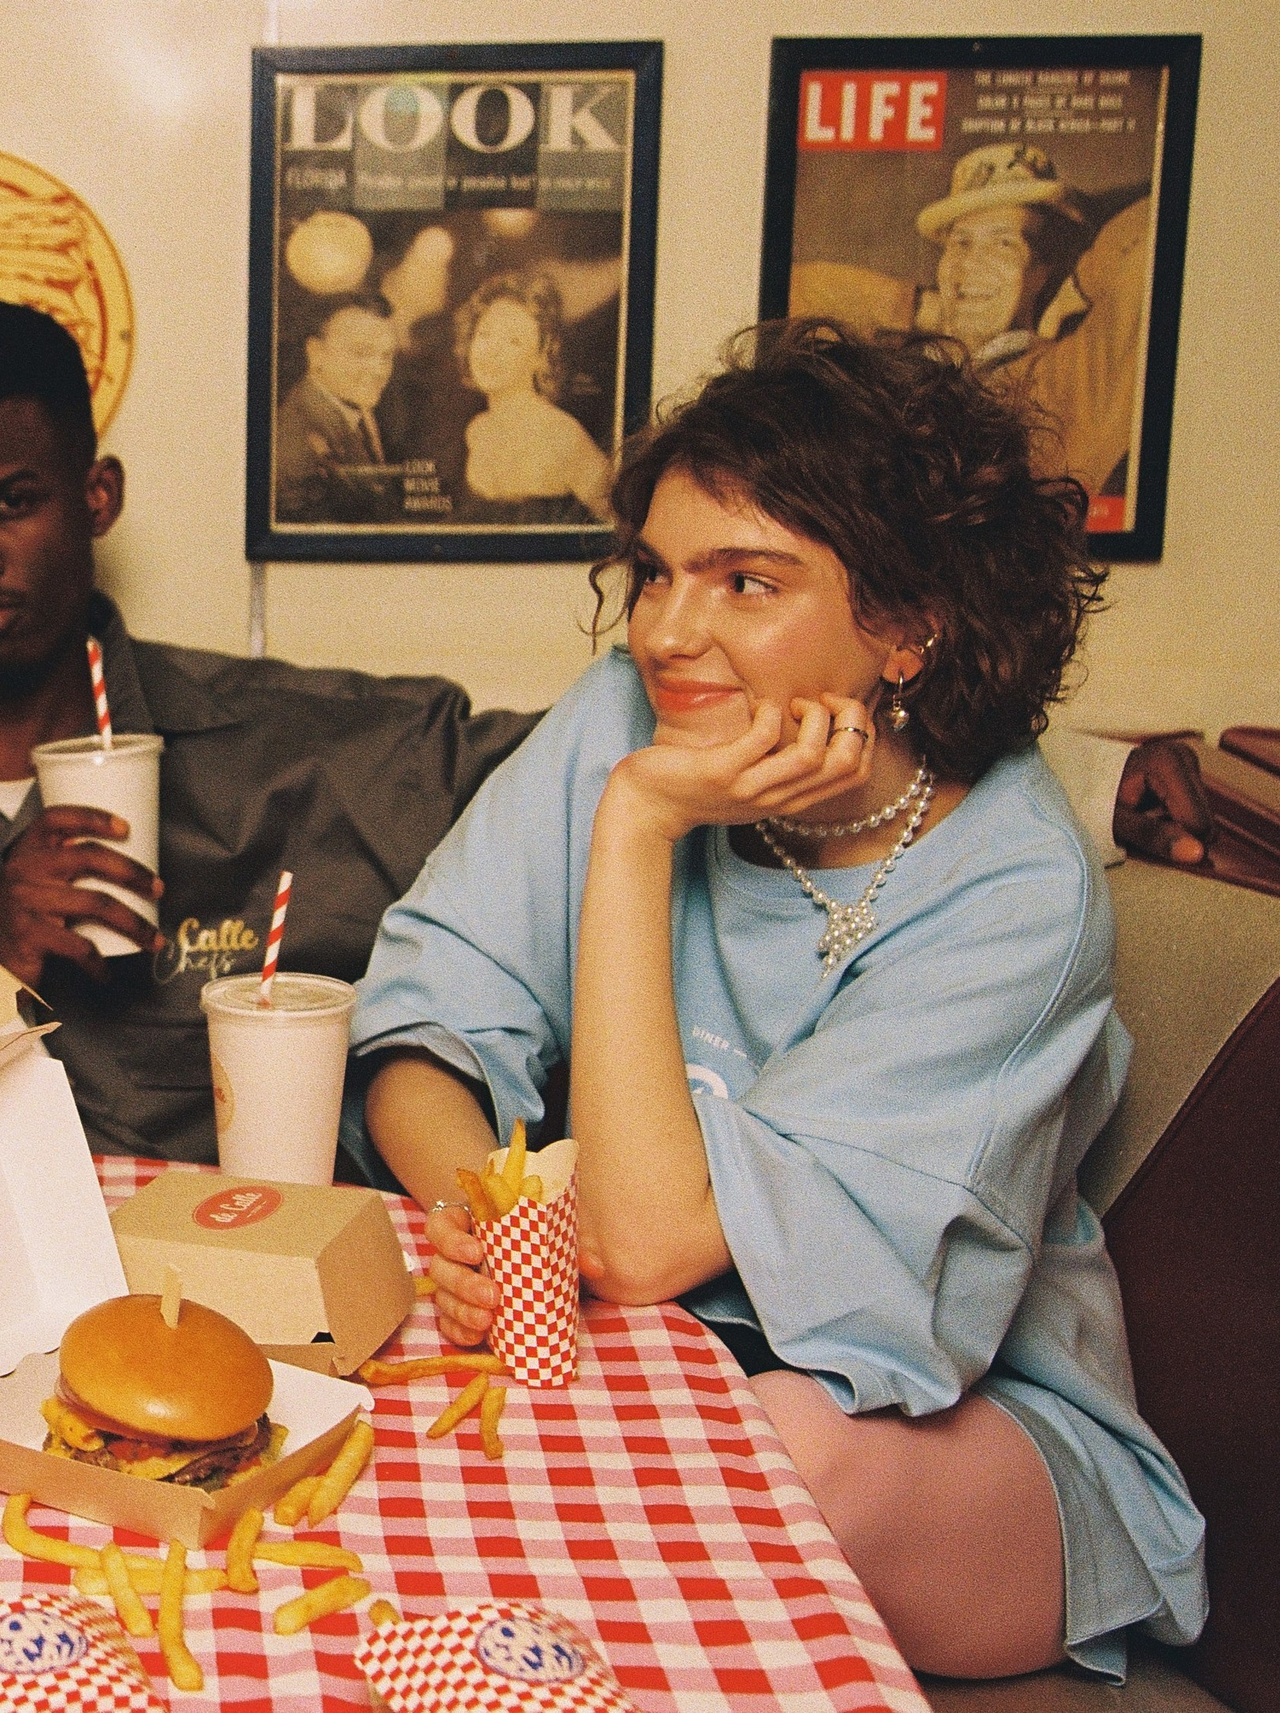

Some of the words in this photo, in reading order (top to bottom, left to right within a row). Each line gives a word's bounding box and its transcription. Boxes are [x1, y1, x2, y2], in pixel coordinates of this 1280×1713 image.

[281, 82, 627, 154] LOOK
[806, 80, 939, 143] LIFE
[691, 1025, 731, 1051] DINER
